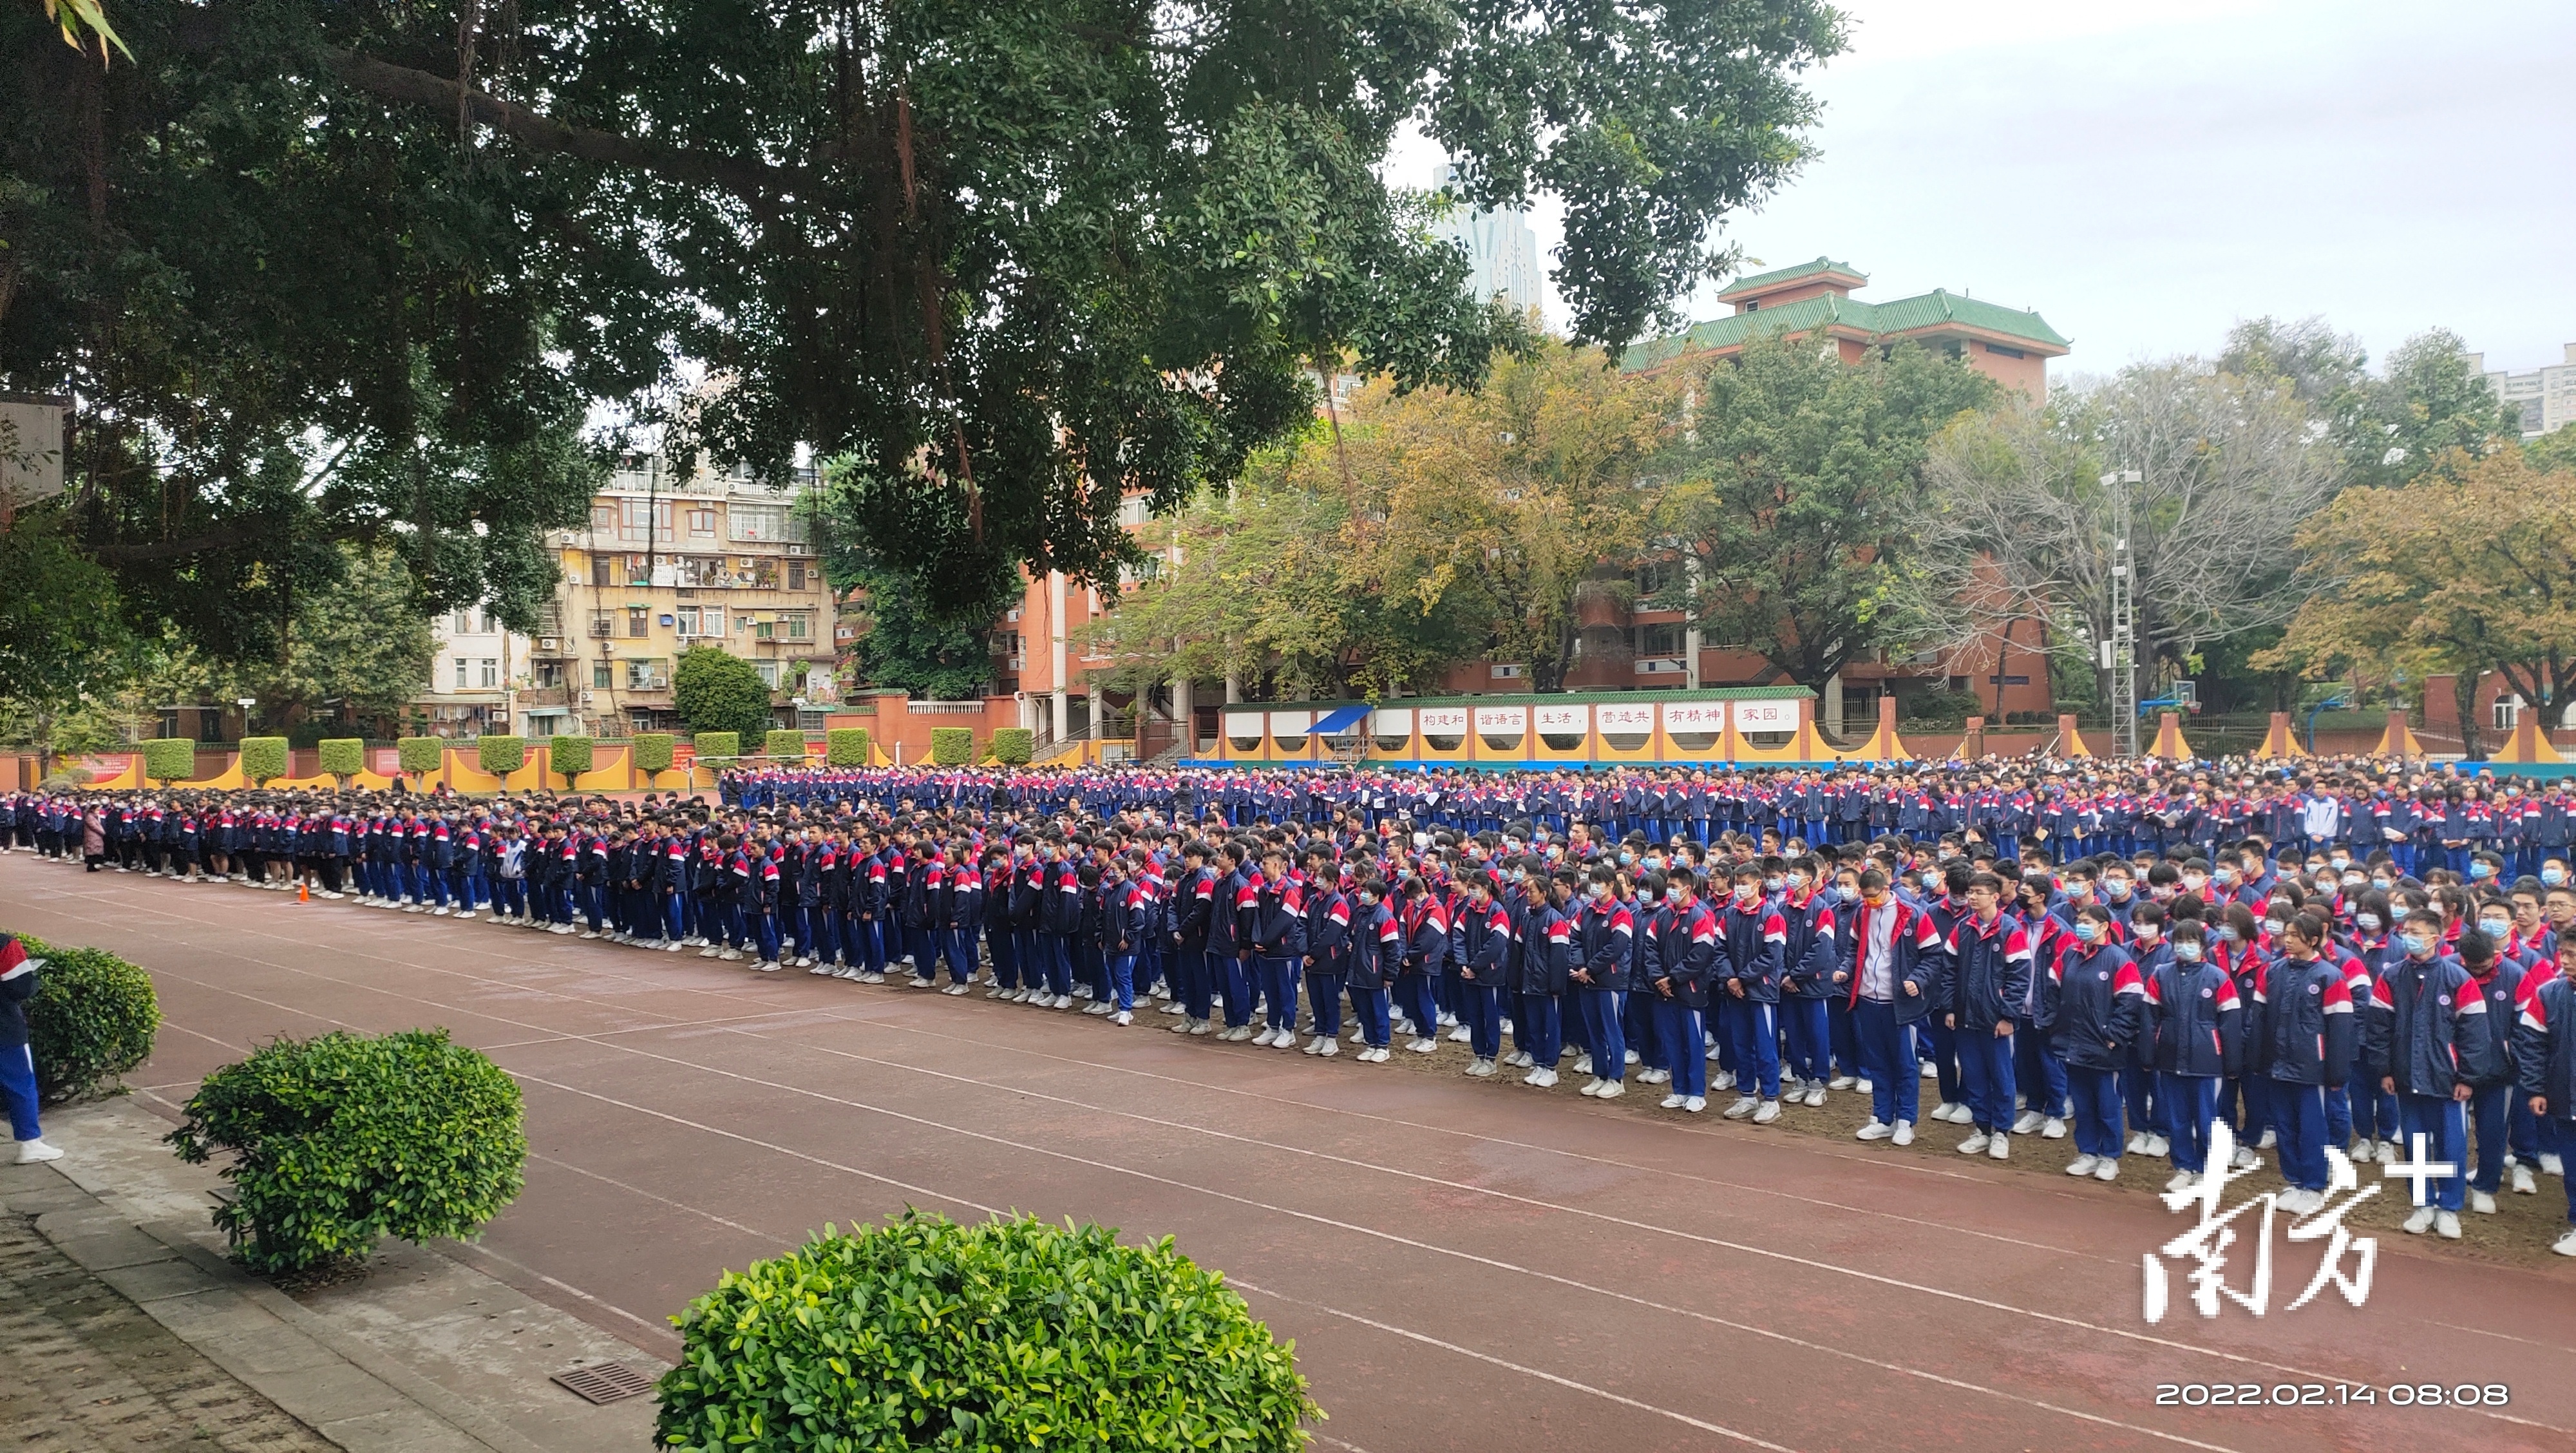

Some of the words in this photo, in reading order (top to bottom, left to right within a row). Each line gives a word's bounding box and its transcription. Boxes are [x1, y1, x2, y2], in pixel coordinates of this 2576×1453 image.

[1423, 714, 1464, 726] 构建和
[1480, 713, 1522, 726] 谐语言
[1602, 710, 1650, 724] 营造共
[1669, 708, 1721, 723] 有精神
